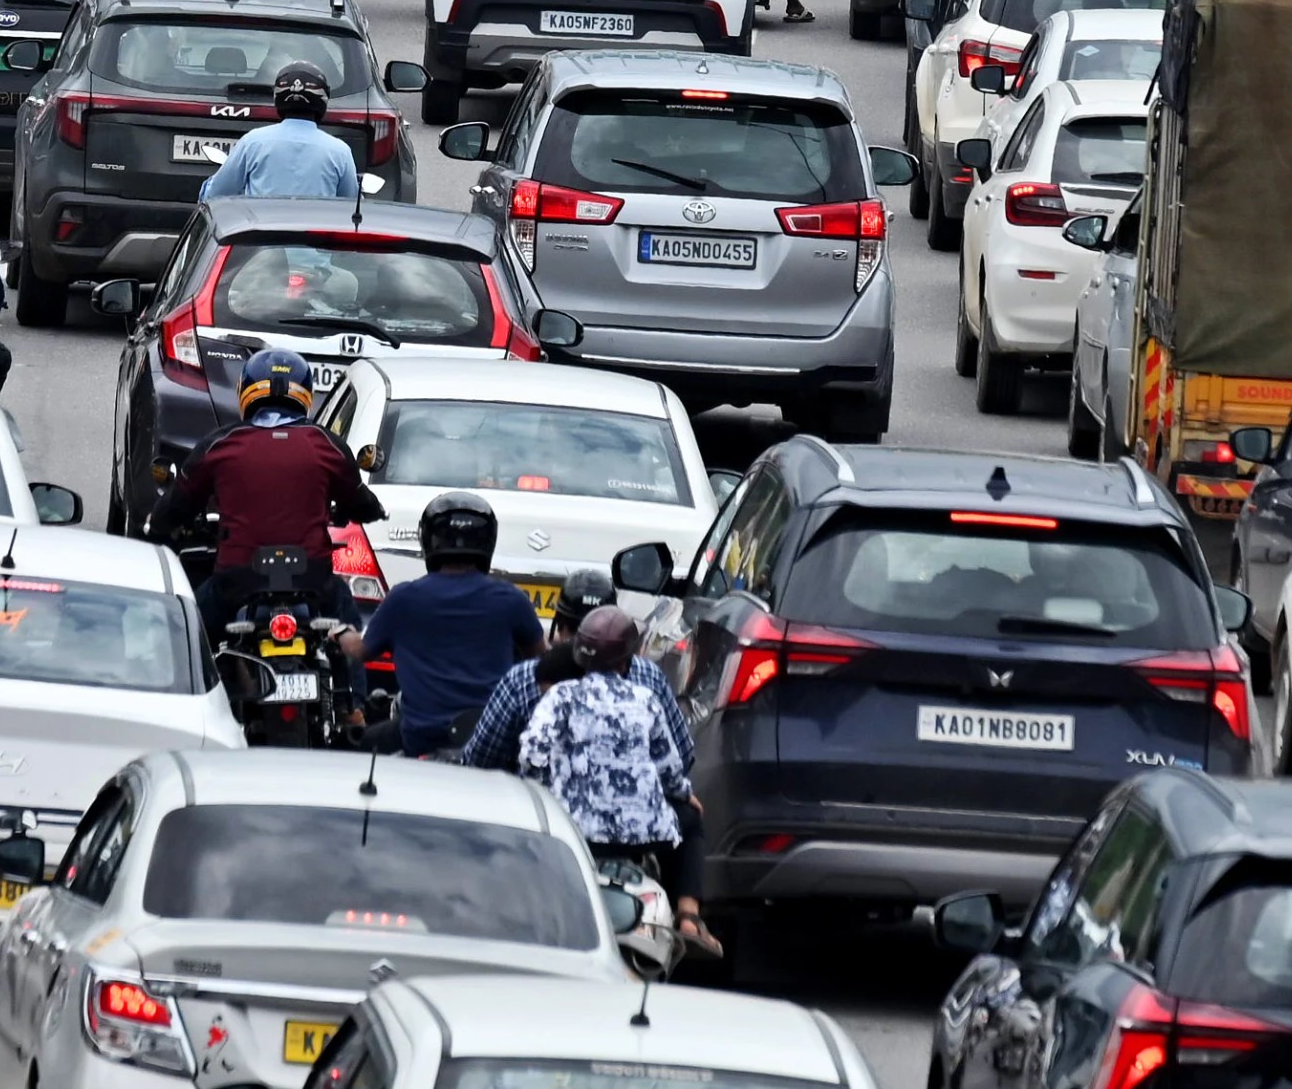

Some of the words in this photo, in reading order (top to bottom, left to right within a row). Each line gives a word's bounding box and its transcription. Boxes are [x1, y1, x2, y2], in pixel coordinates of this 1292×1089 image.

[549, 14, 633, 32] KA05NF2360
[651, 238, 753, 262] KA05ND0455
[207, 351, 243, 361] HONDA
[934, 713, 1066, 743] KA01NB8081
